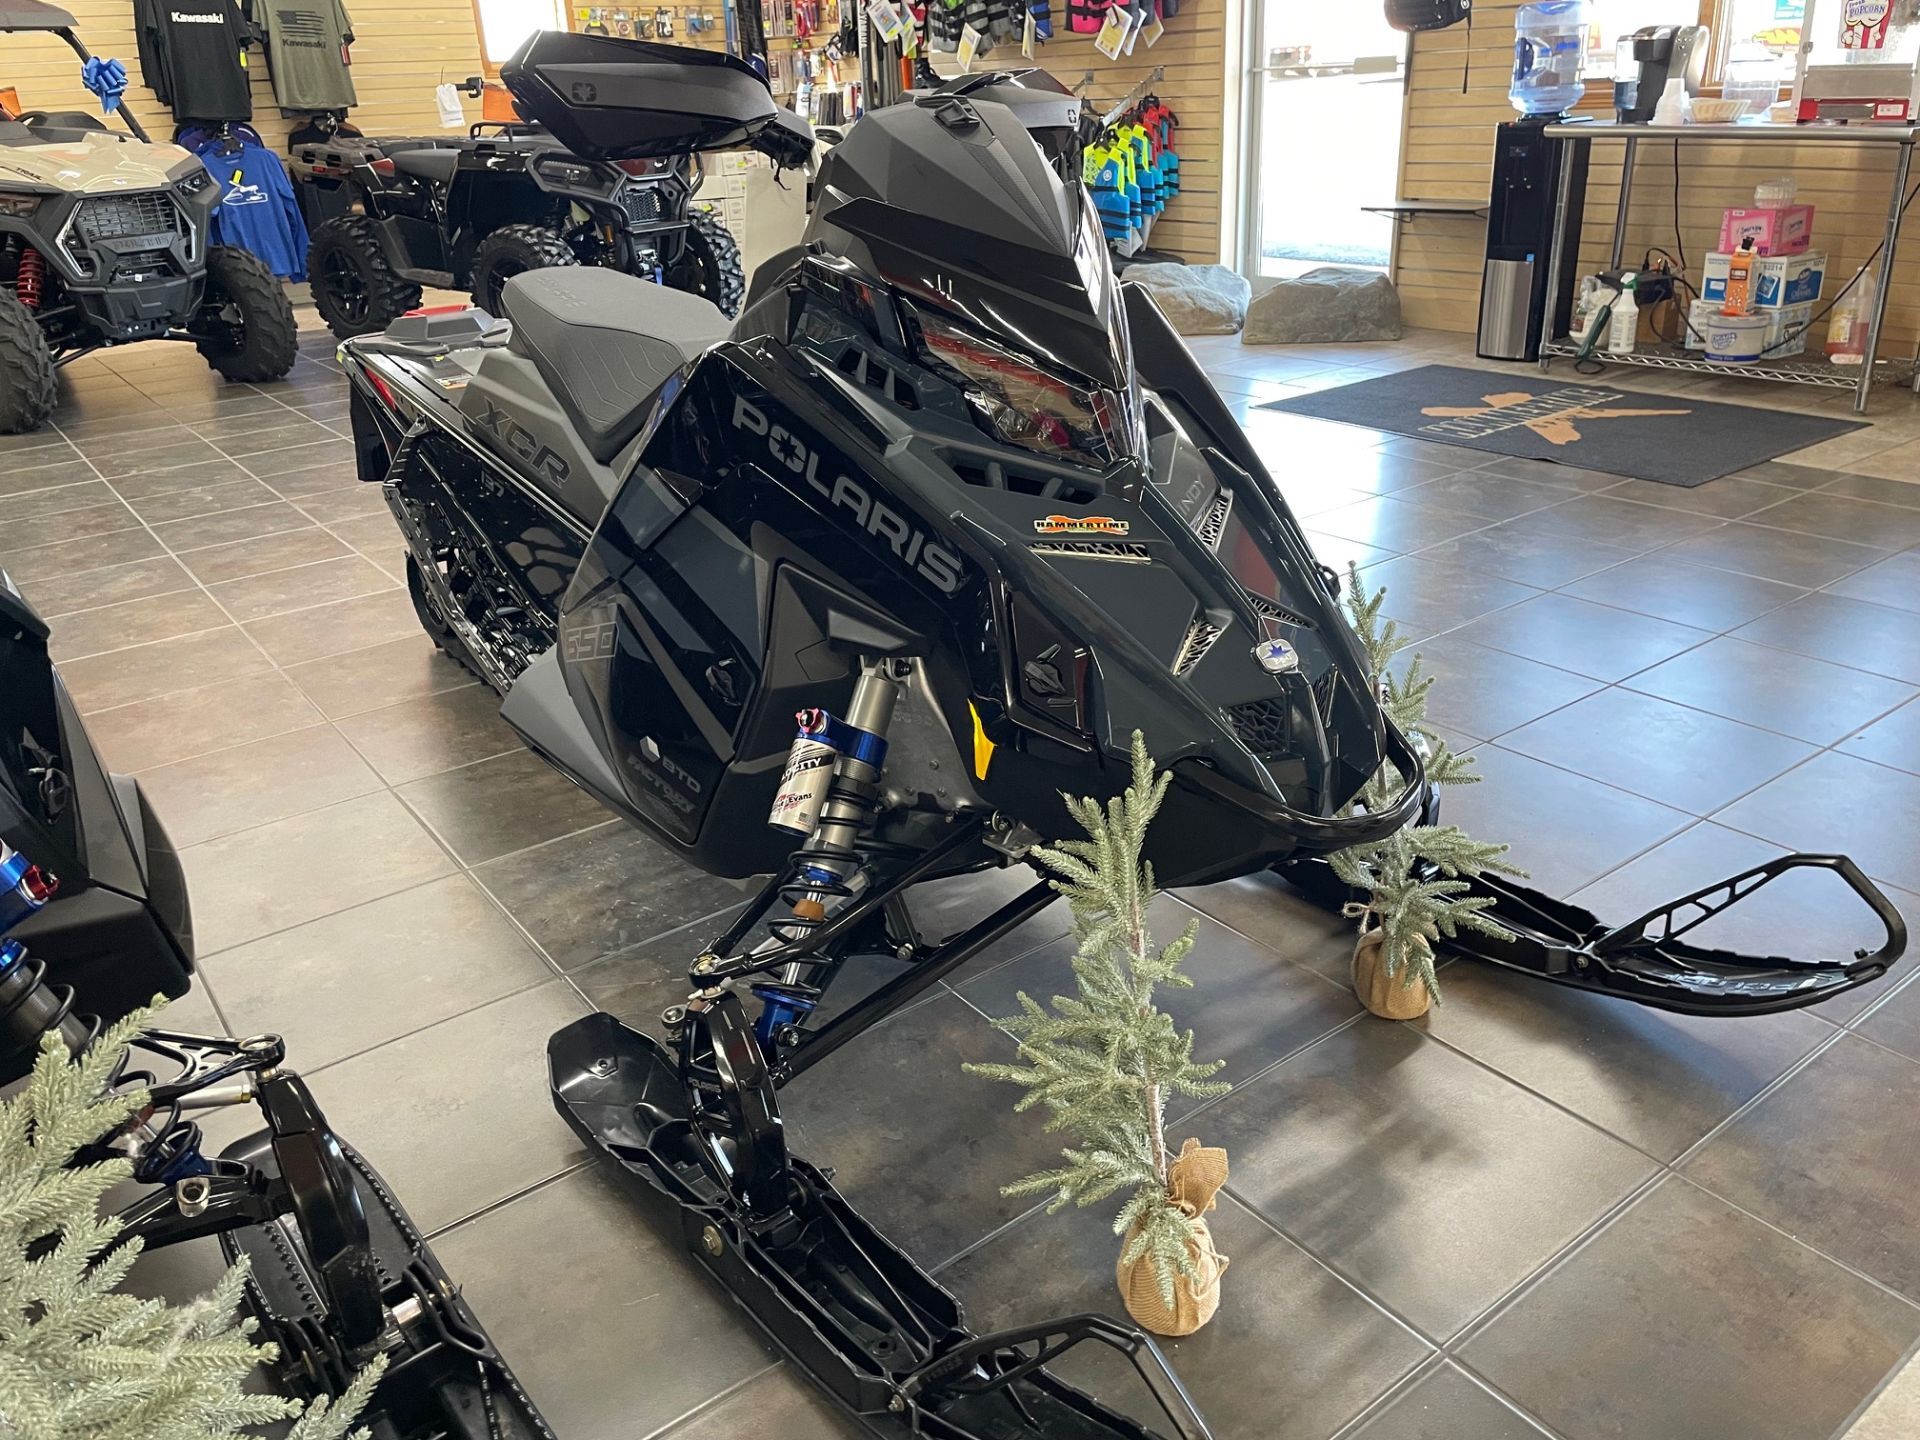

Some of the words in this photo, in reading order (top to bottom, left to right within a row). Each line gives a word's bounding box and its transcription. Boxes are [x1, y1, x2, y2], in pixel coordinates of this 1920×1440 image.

[171, 12, 224, 24] Kawasaki
[1850, 5, 1886, 17] POPCORN
[282, 38, 326, 49] Kawasaki
[859, 15, 868, 49] YAMAHA
[476, 395, 572, 489] XCR
[481, 470, 505, 498] 137
[732, 394, 962, 593] POLARIS
[1178, 475, 1205, 516] INDY
[1035, 521, 1128, 529] HAMMERTIME
[565, 621, 619, 662] 650
[788, 792, 813, 804] Evans
